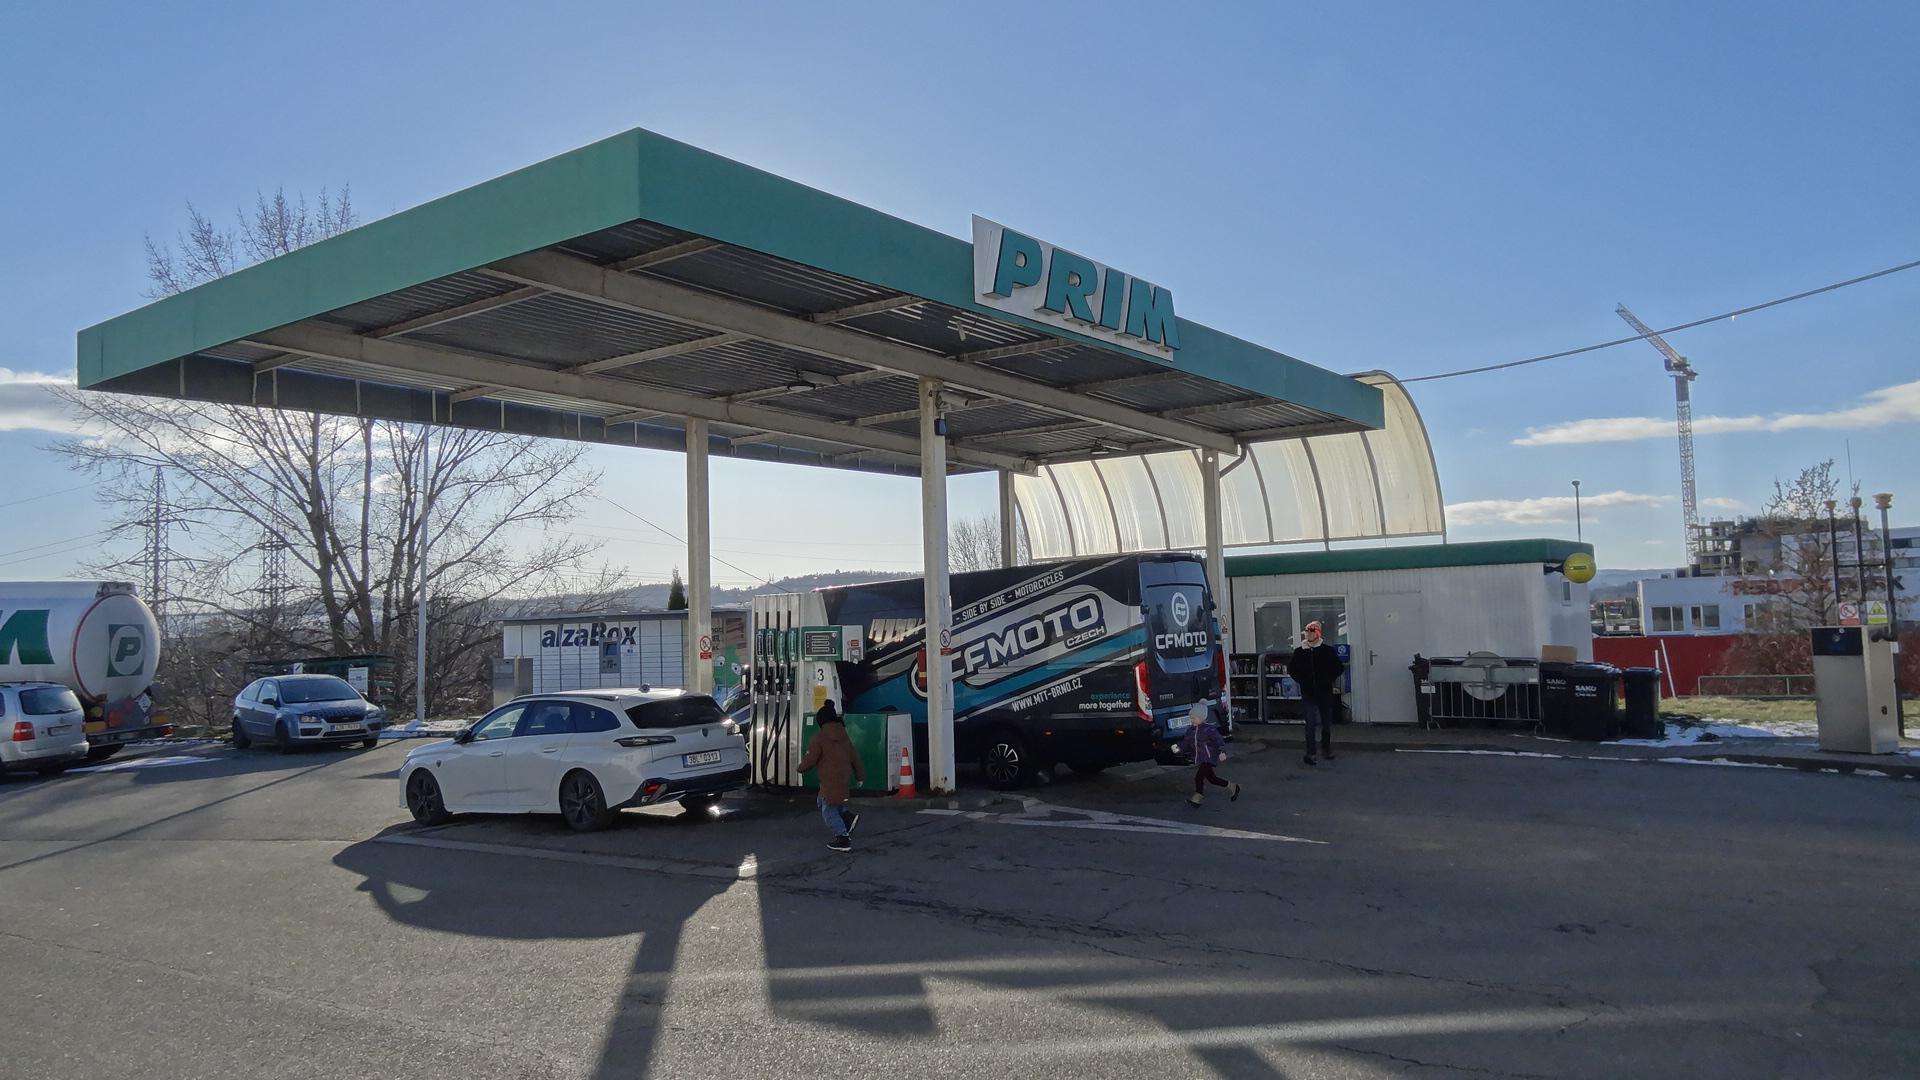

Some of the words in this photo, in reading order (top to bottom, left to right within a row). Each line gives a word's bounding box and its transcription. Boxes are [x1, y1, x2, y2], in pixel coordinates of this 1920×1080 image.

[990, 227, 1181, 351] PRIM
[962, 607, 978, 621] SIDE
[979, 602, 989, 613] BY
[990, 596, 1006, 609] SIDE
[1014, 571, 1064, 599] MOTORCYCLES
[541, 622, 637, 648] alzaBox
[1066, 626, 1105, 647] CZECH
[1155, 631, 1207, 650] CFMOTO
[115, 637, 141, 662] P
[817, 668, 825, 682] 3
[1011, 678, 1083, 713] WWW.MTT-BRNO.CZ
[1079, 702, 1098, 710] more
[1099, 699, 1132, 711] together
